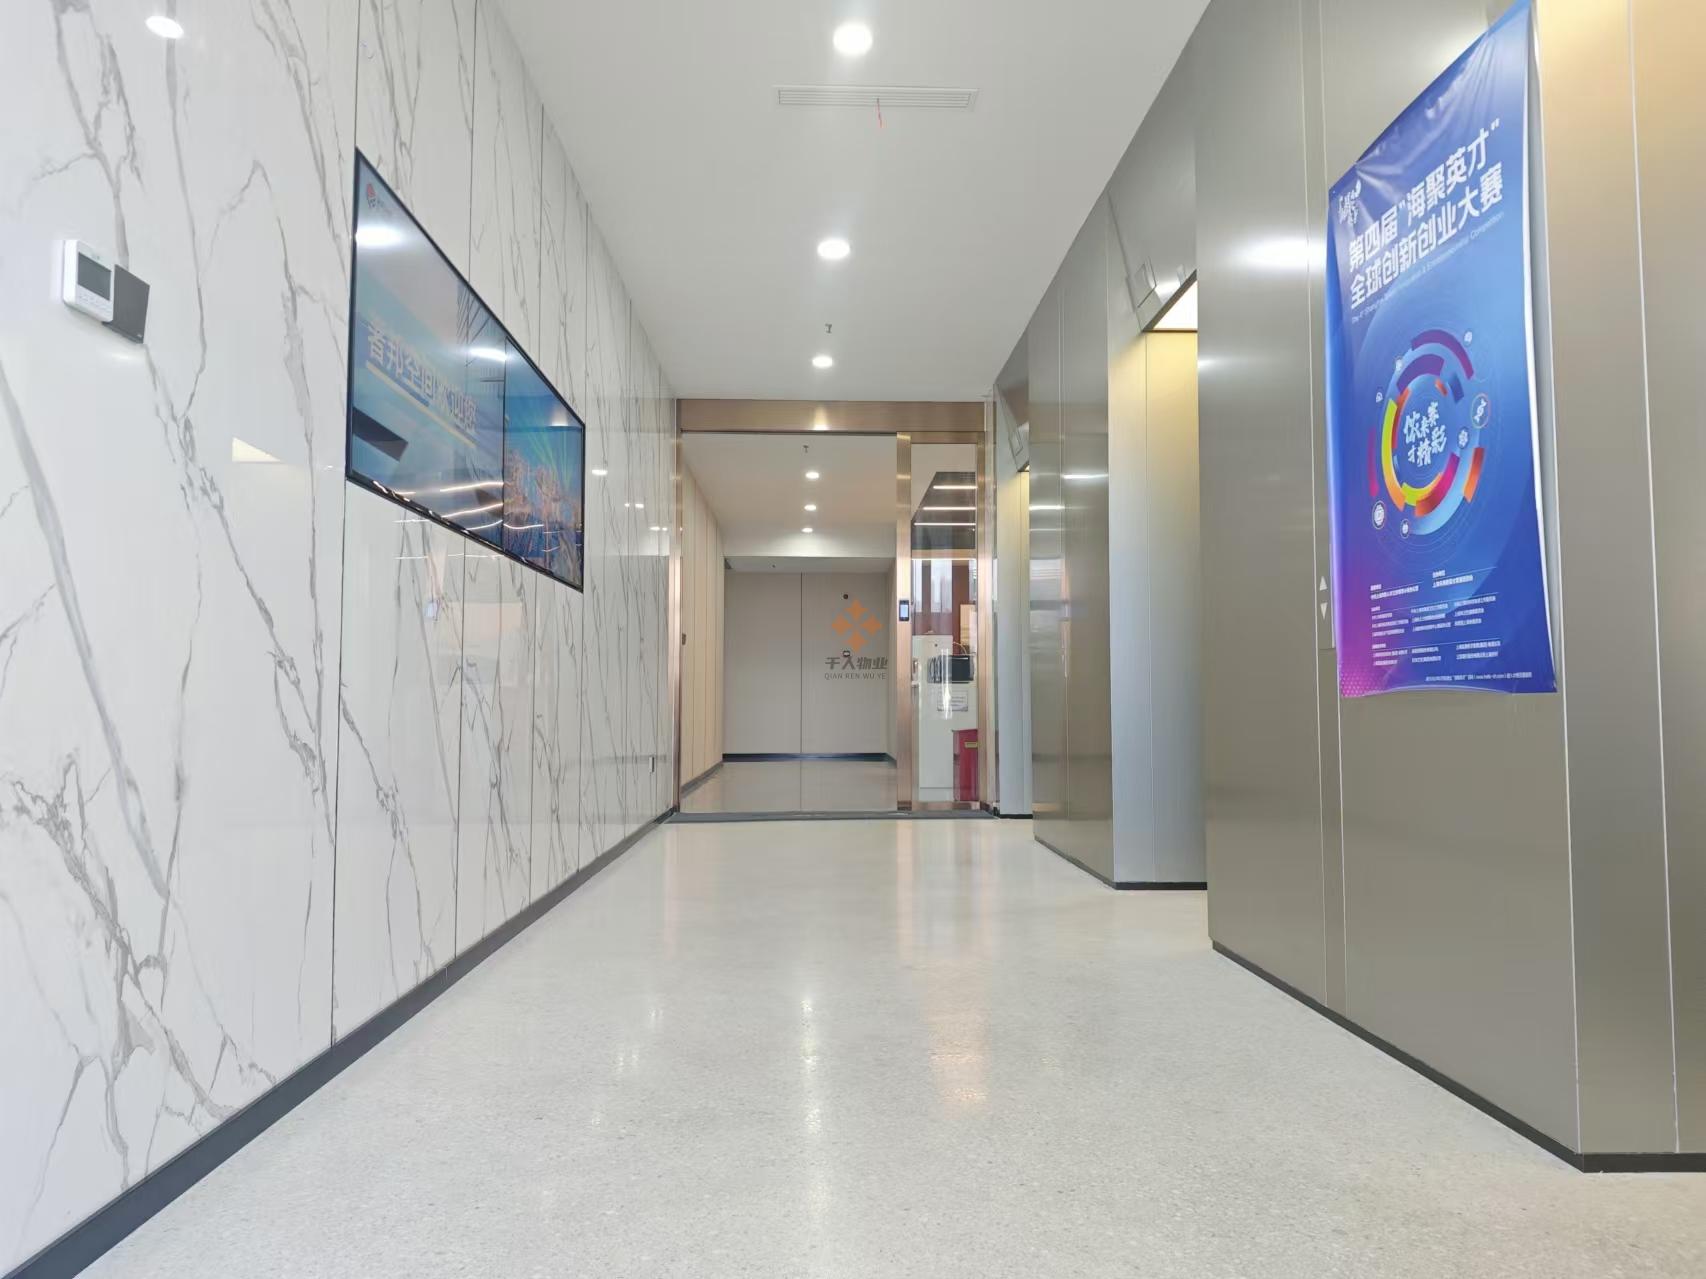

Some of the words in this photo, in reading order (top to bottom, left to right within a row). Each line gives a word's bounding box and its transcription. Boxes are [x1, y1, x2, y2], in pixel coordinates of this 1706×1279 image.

[1350, 161, 1503, 309] 全球创新创业大赛
[824, 655, 888, 670] 千人物业
[824, 672, 843, 680] QIAN
[845, 672, 860, 680] REN
[862, 672, 875, 680] WU
[877, 672, 887, 680] YE
